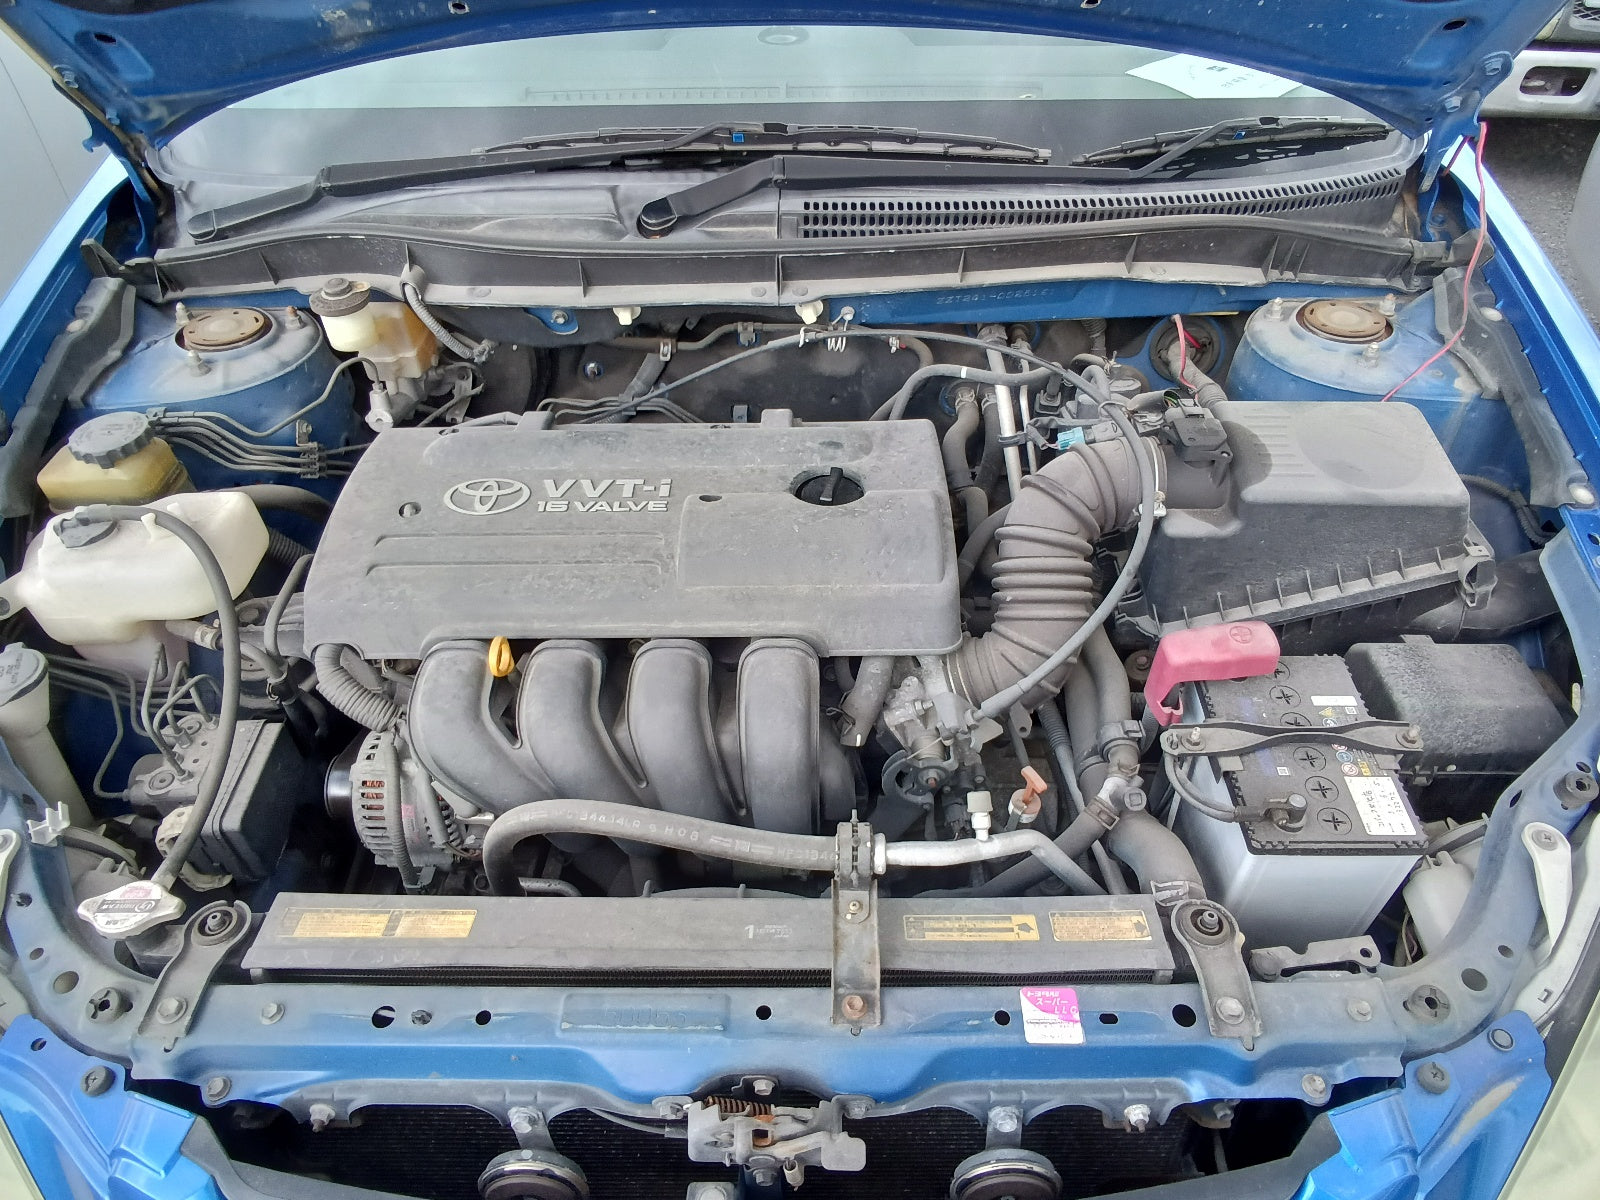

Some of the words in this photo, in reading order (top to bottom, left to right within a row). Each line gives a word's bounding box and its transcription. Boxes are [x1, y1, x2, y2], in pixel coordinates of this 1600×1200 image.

[543, 478, 672, 498] VVT-i
[537, 500, 570, 512] 16
[573, 500, 669, 512] VALVE
[1035, 997, 1069, 1006] スーパー
